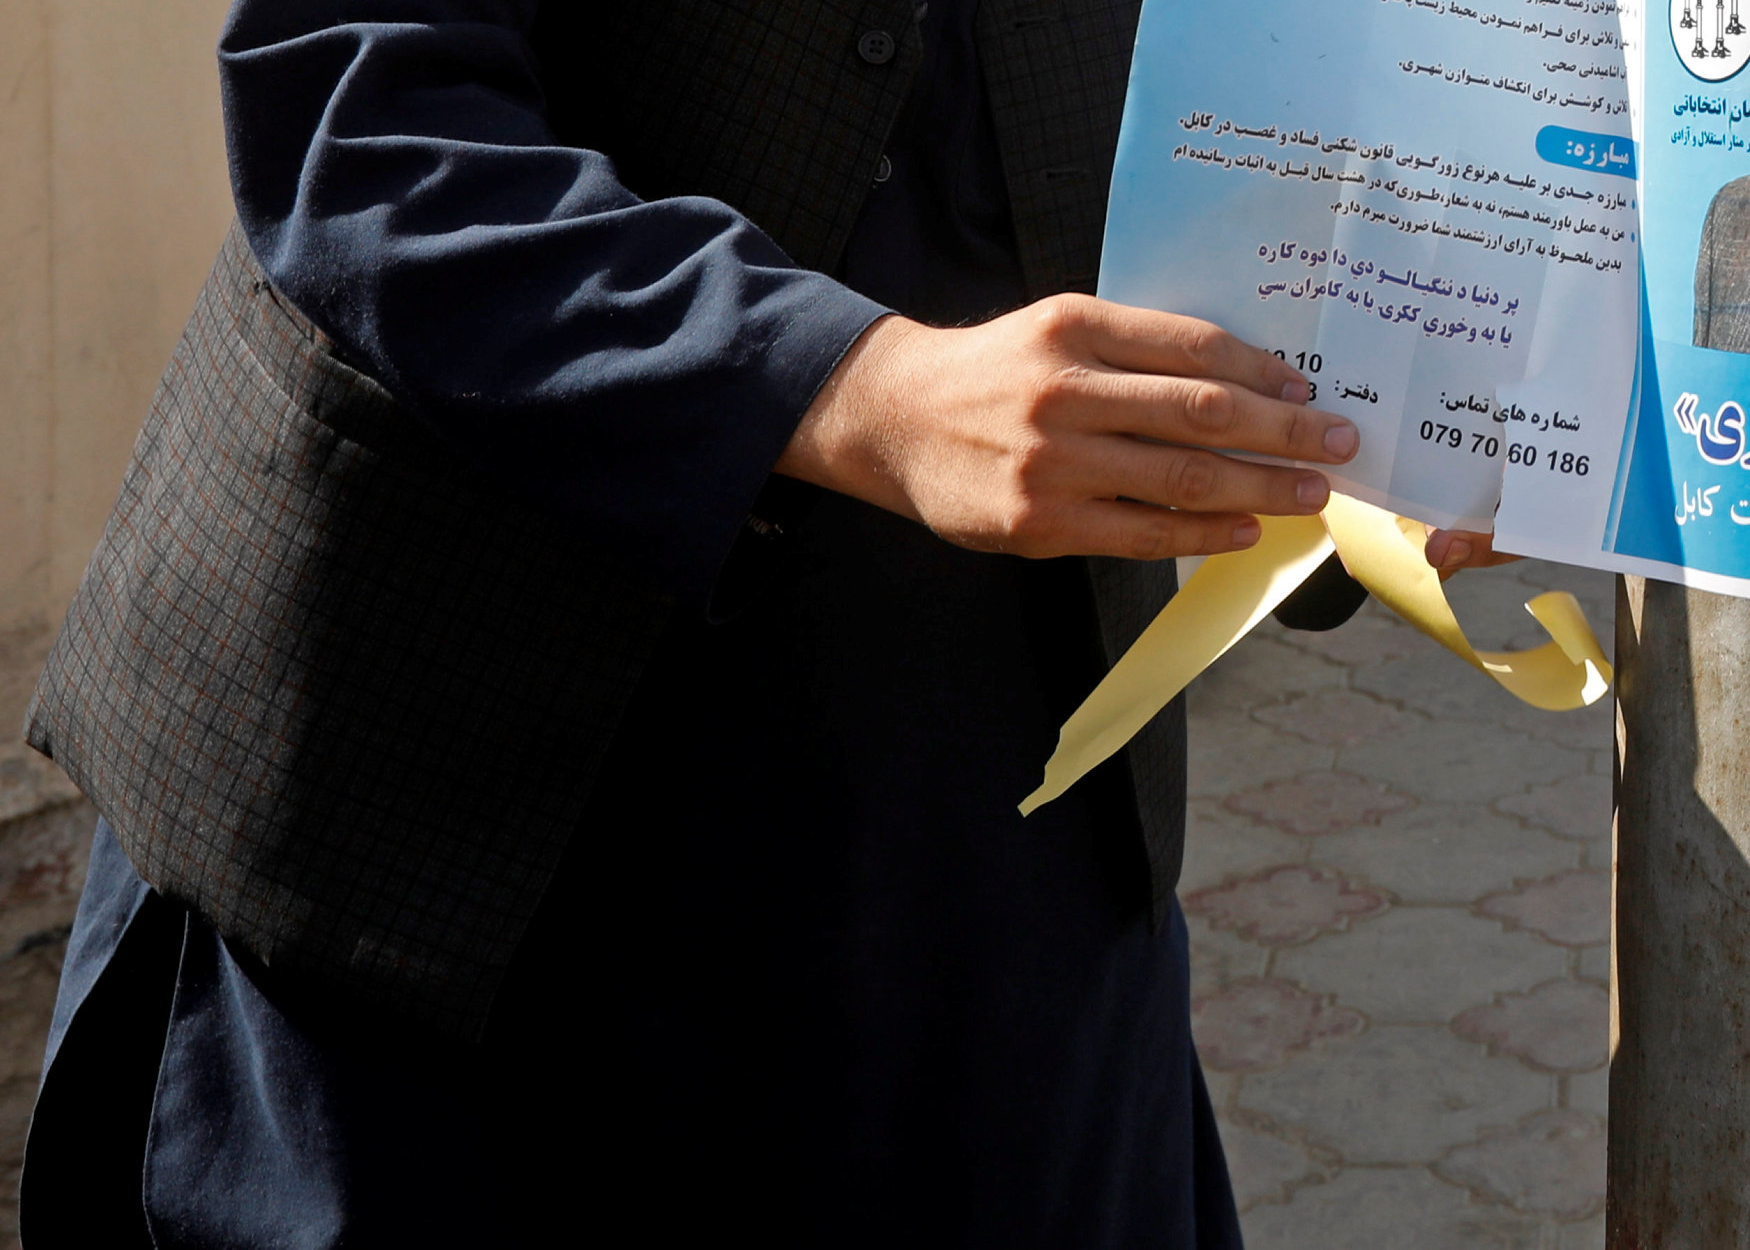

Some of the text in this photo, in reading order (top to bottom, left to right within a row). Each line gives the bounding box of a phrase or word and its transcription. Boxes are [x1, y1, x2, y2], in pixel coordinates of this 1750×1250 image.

[1295, 351, 1323, 374] 10
[1420, 420, 1590, 476] 079 70 60 186
[1675, 480, 1721, 526] کابل
